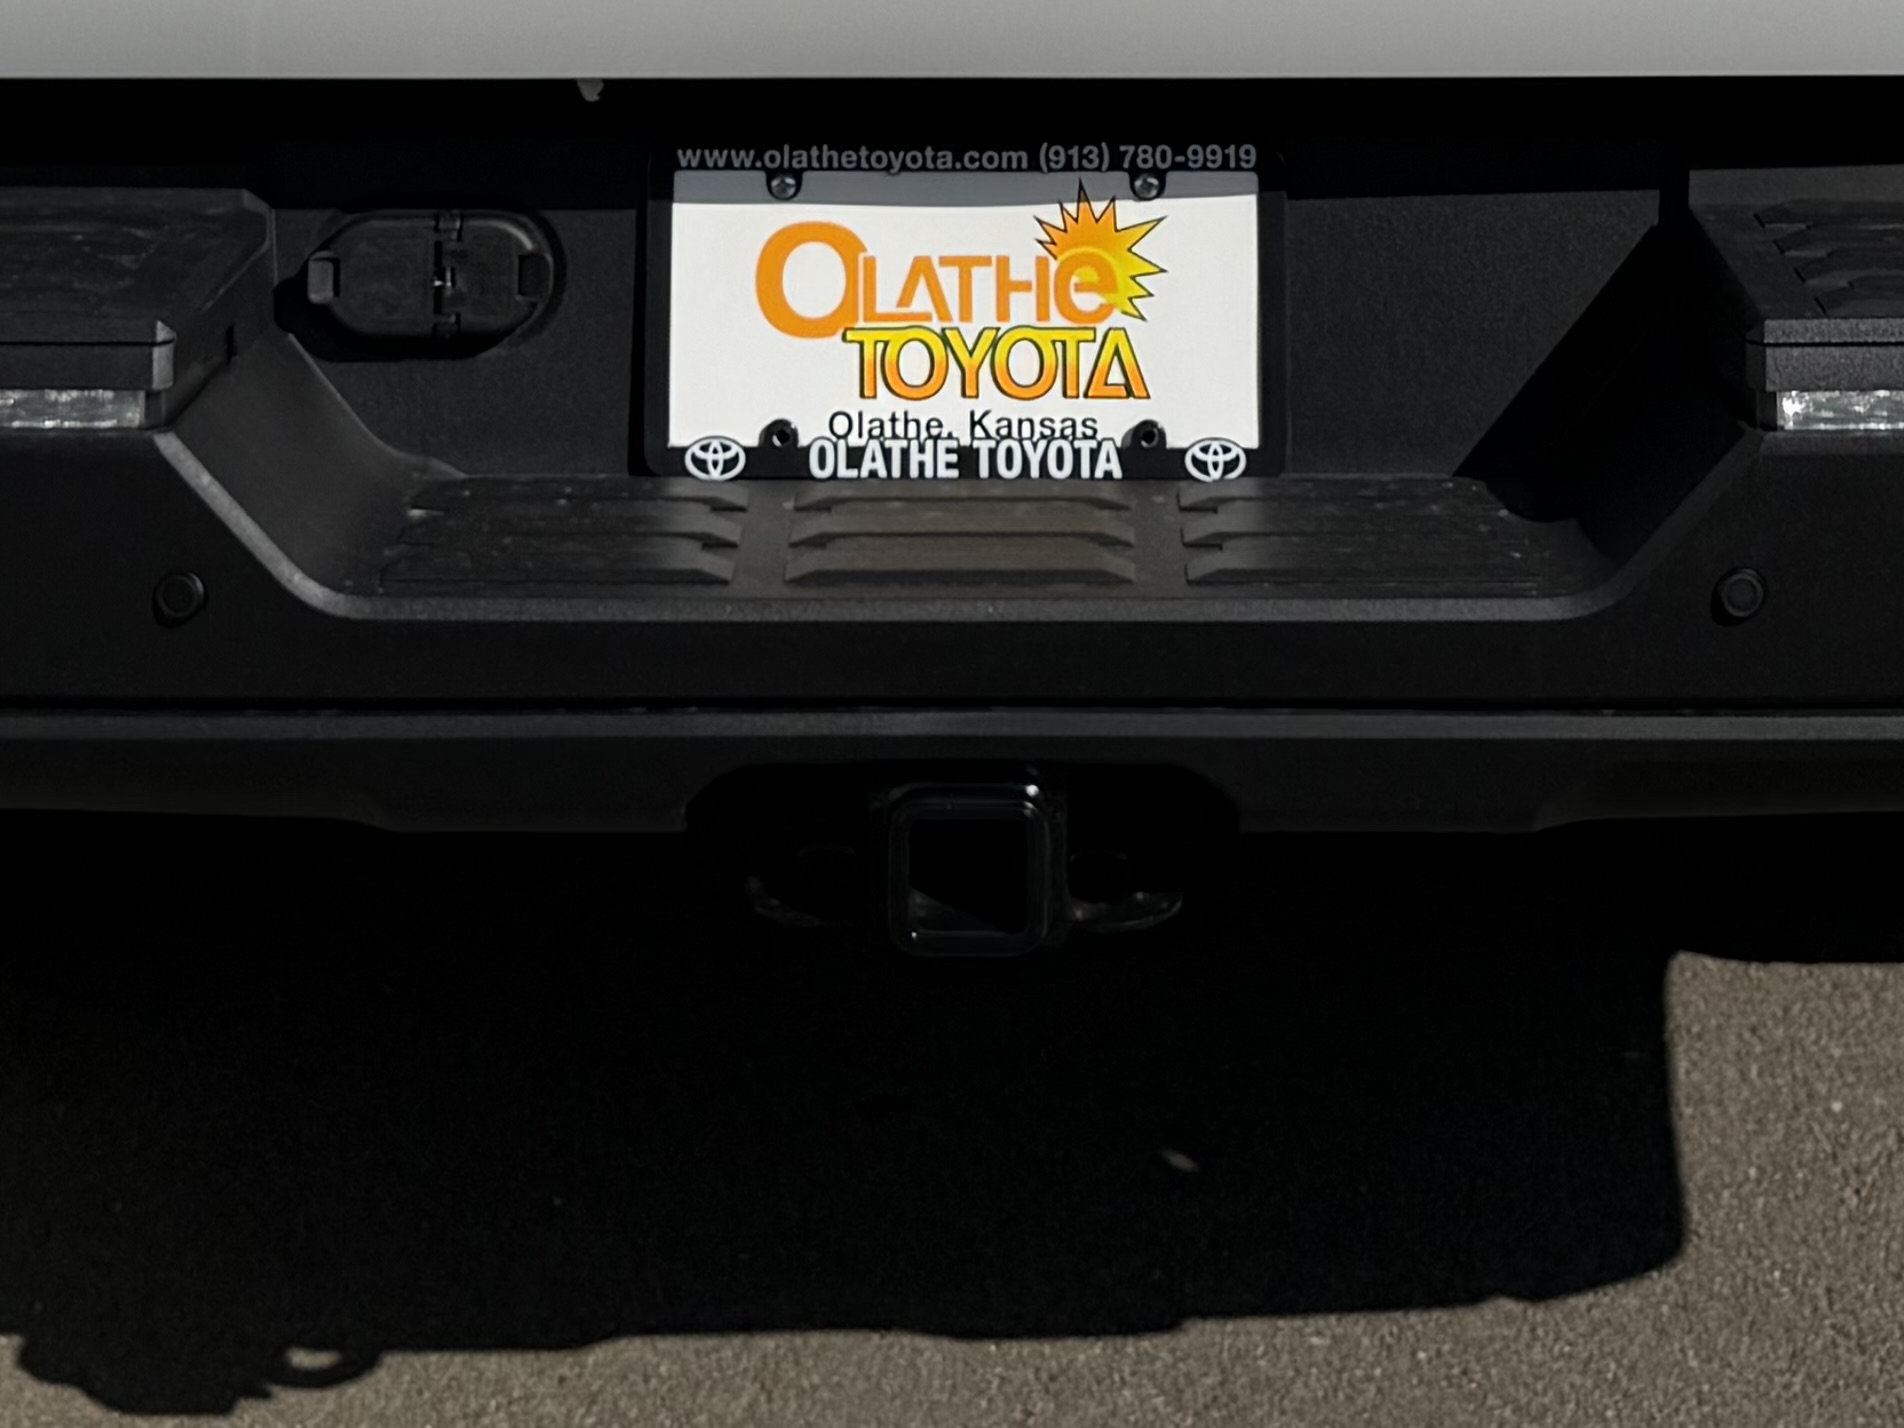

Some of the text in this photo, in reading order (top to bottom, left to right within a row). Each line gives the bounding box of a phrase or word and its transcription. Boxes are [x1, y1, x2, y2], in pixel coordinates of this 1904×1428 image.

[676, 142, 1257, 175] www.olathetoyota.com (913) 780-9919
[841, 325, 1152, 401] TOYOTA
[969, 409, 1099, 441] Kansas
[808, 436, 1124, 480] OLATHE TOYOTA
